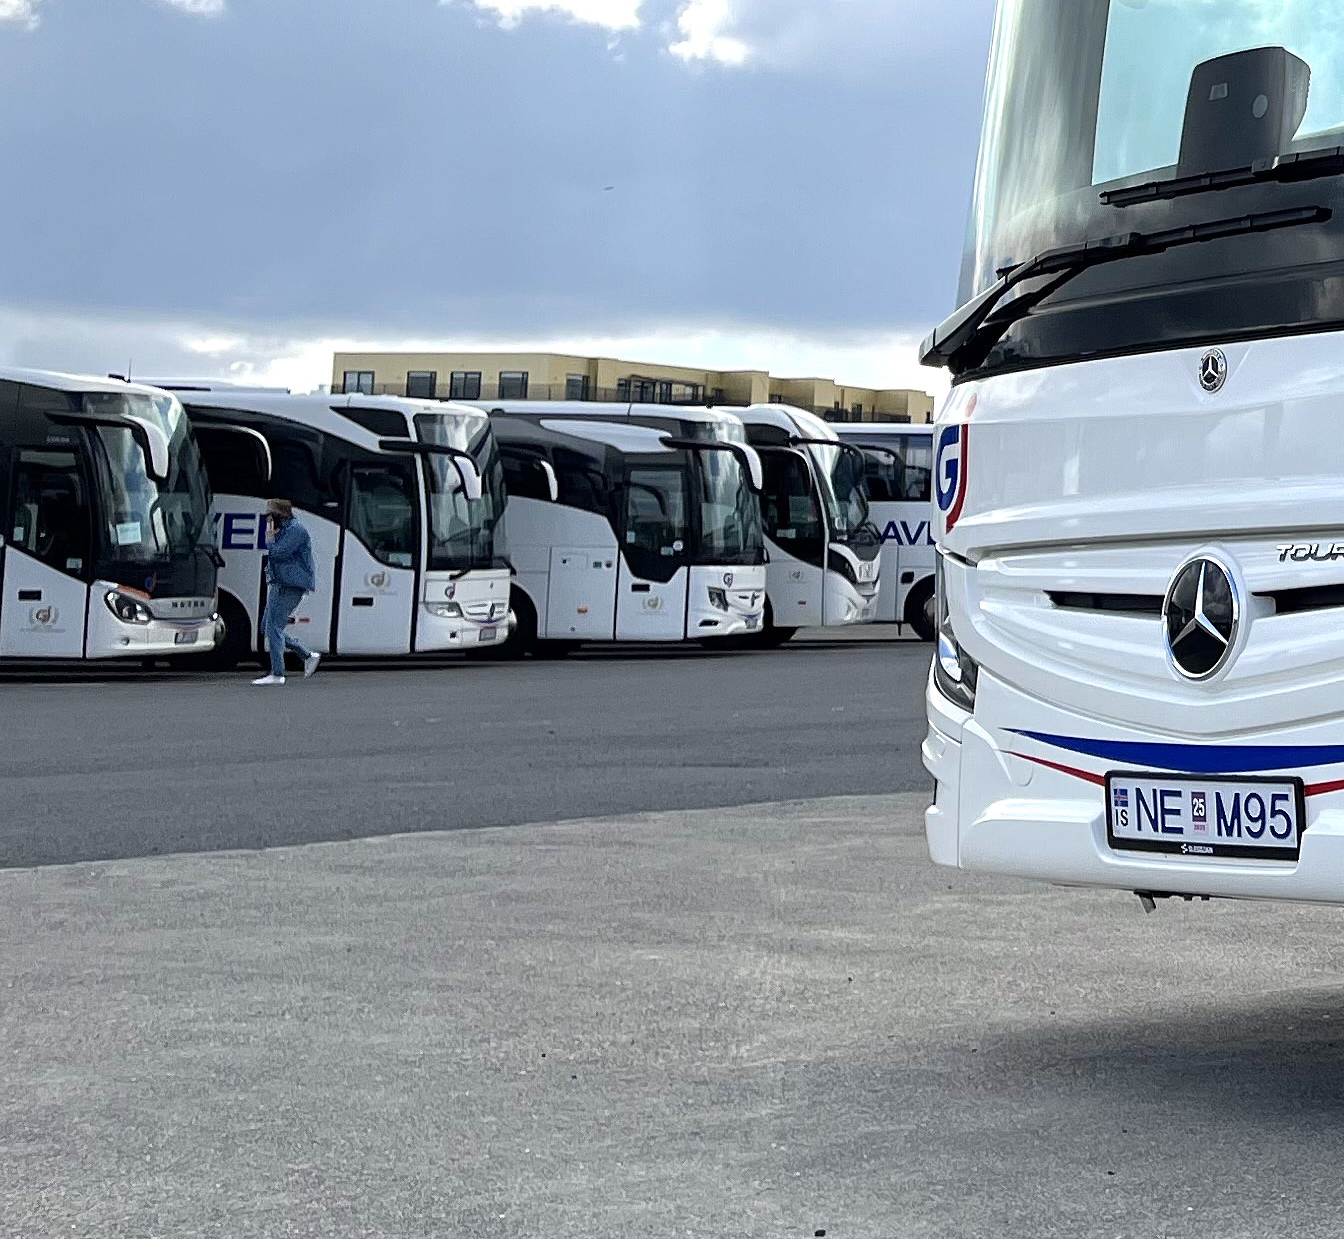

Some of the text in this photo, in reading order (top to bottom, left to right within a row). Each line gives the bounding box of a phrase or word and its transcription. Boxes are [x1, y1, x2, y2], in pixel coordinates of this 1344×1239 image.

[1135, 787, 1292, 840] NE M95
[1192, 797, 1205, 817] 25
[1115, 809, 1128, 827] IS
